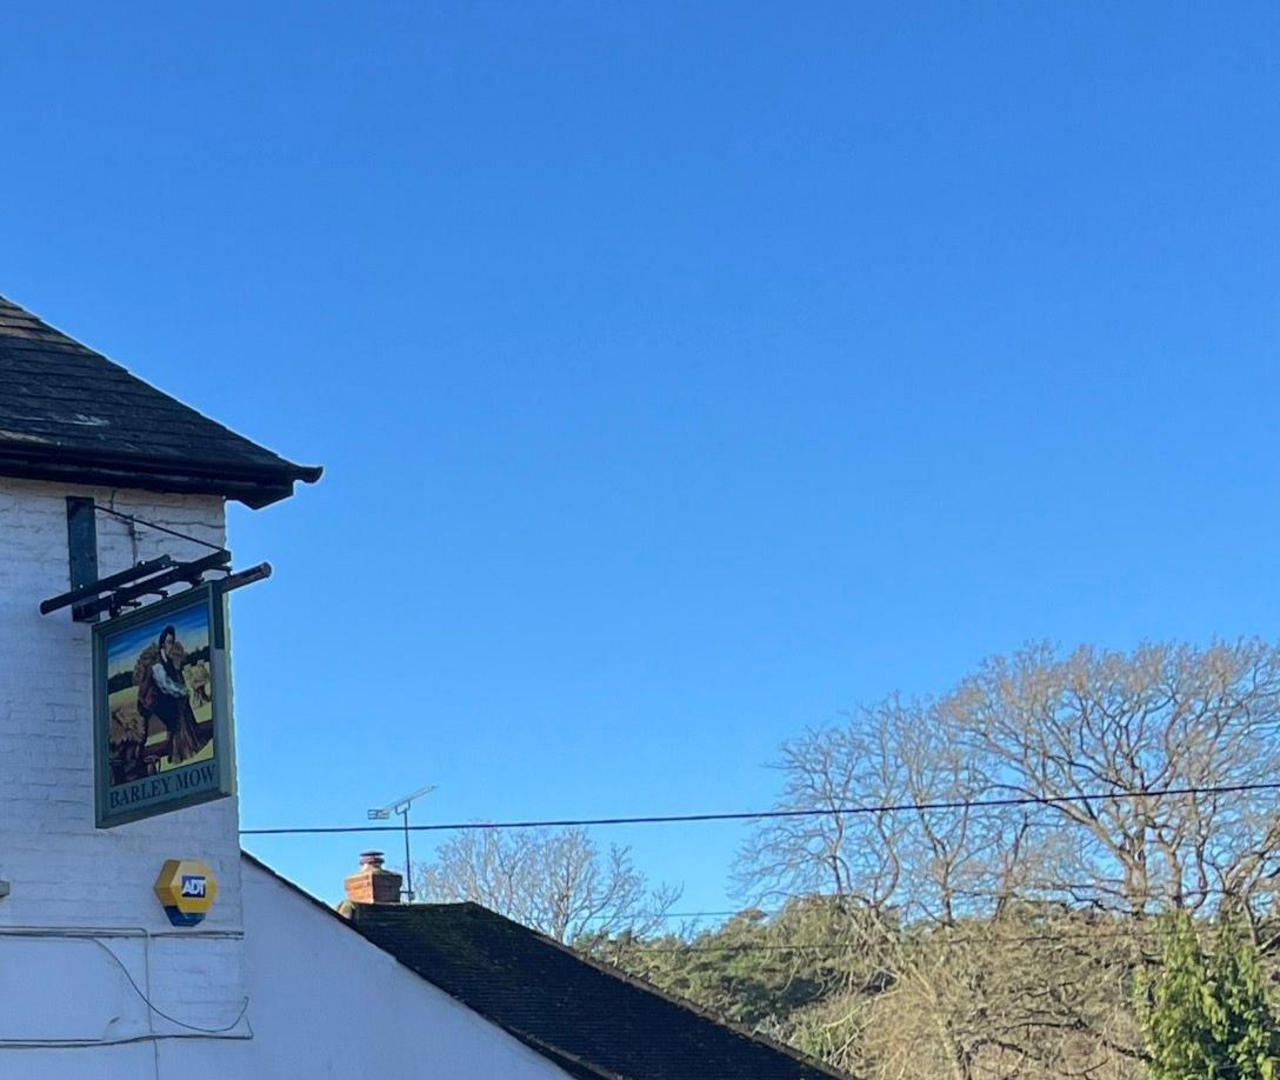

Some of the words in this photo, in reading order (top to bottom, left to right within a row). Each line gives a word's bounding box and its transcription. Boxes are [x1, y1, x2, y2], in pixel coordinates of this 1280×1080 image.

[110, 776, 173, 808] BARLEY
[176, 764, 216, 792] MOW
[181, 879, 207, 895] ADT
